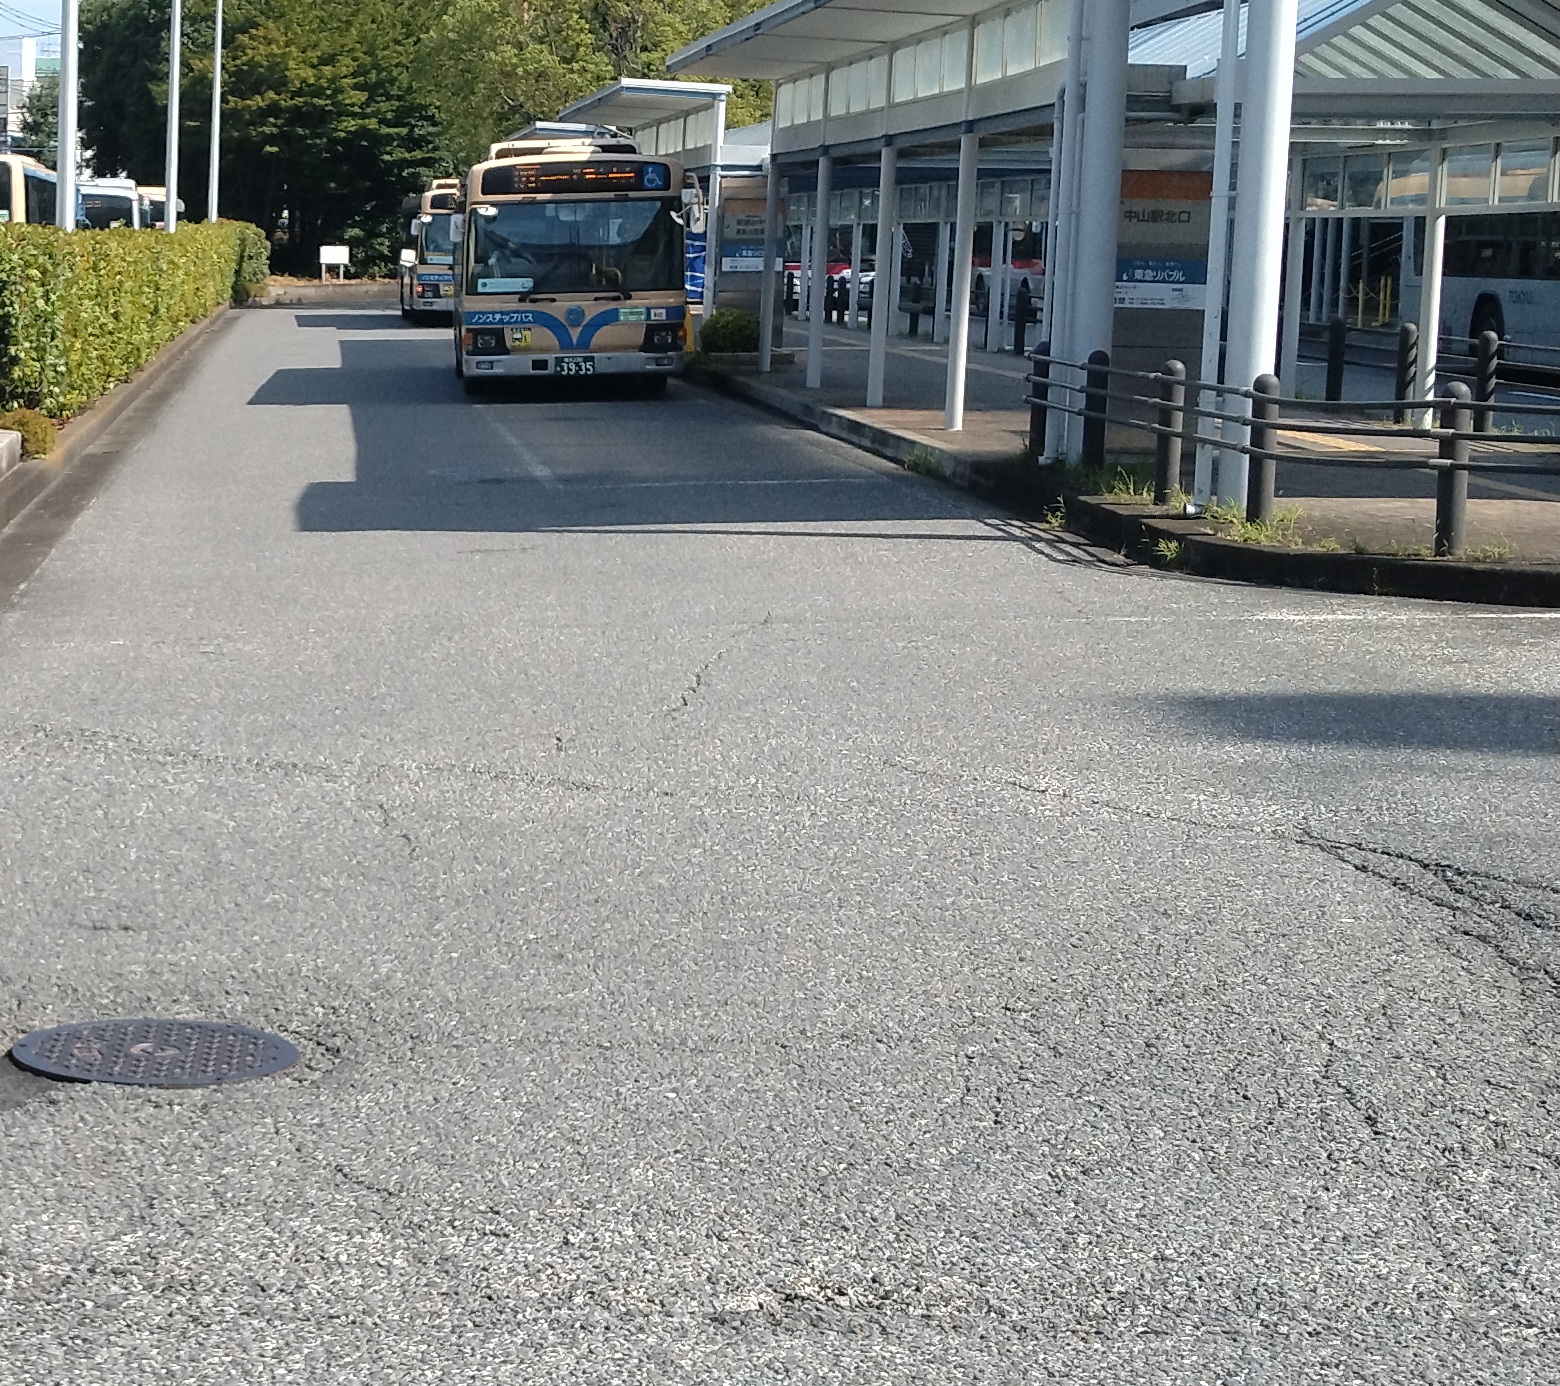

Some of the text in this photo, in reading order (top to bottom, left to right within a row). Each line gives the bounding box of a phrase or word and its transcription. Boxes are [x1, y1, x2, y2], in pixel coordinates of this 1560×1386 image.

[1123, 209, 1191, 224] 中山駅北口
[1133, 268, 1186, 283] 東急リバブル
[472, 314, 534, 323] ノンステップバス
[561, 361, 594, 375] 39-35
